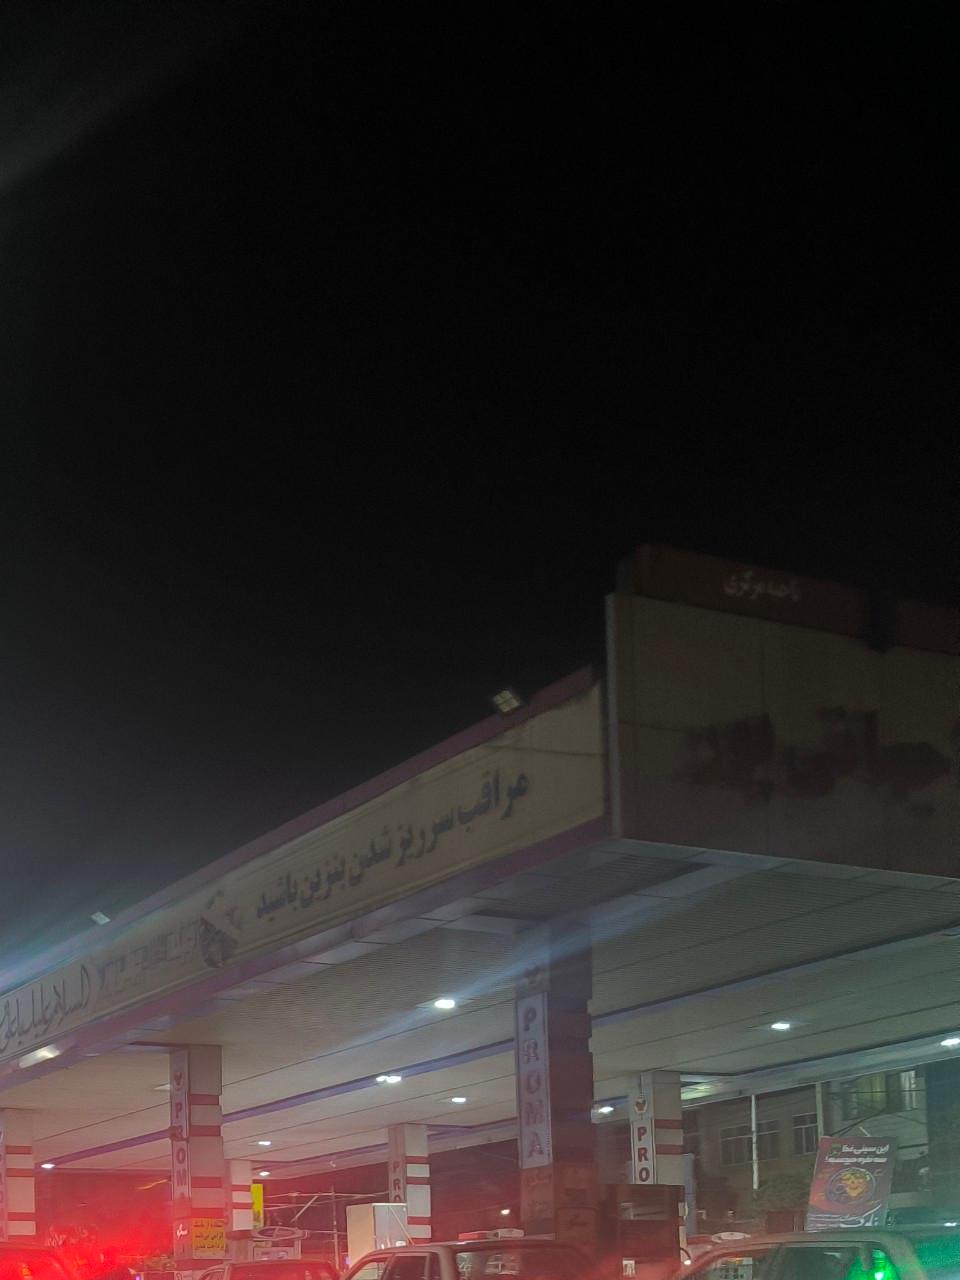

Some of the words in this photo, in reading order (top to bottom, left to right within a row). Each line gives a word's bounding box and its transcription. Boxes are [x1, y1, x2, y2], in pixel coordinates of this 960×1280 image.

[458, 768, 529, 833] مراقب
[302, 854, 345, 908] بنزین
[349, 825, 391, 886] شدن
[255, 869, 298, 921] باشید
[637, 1126, 650, 1182] PRO
